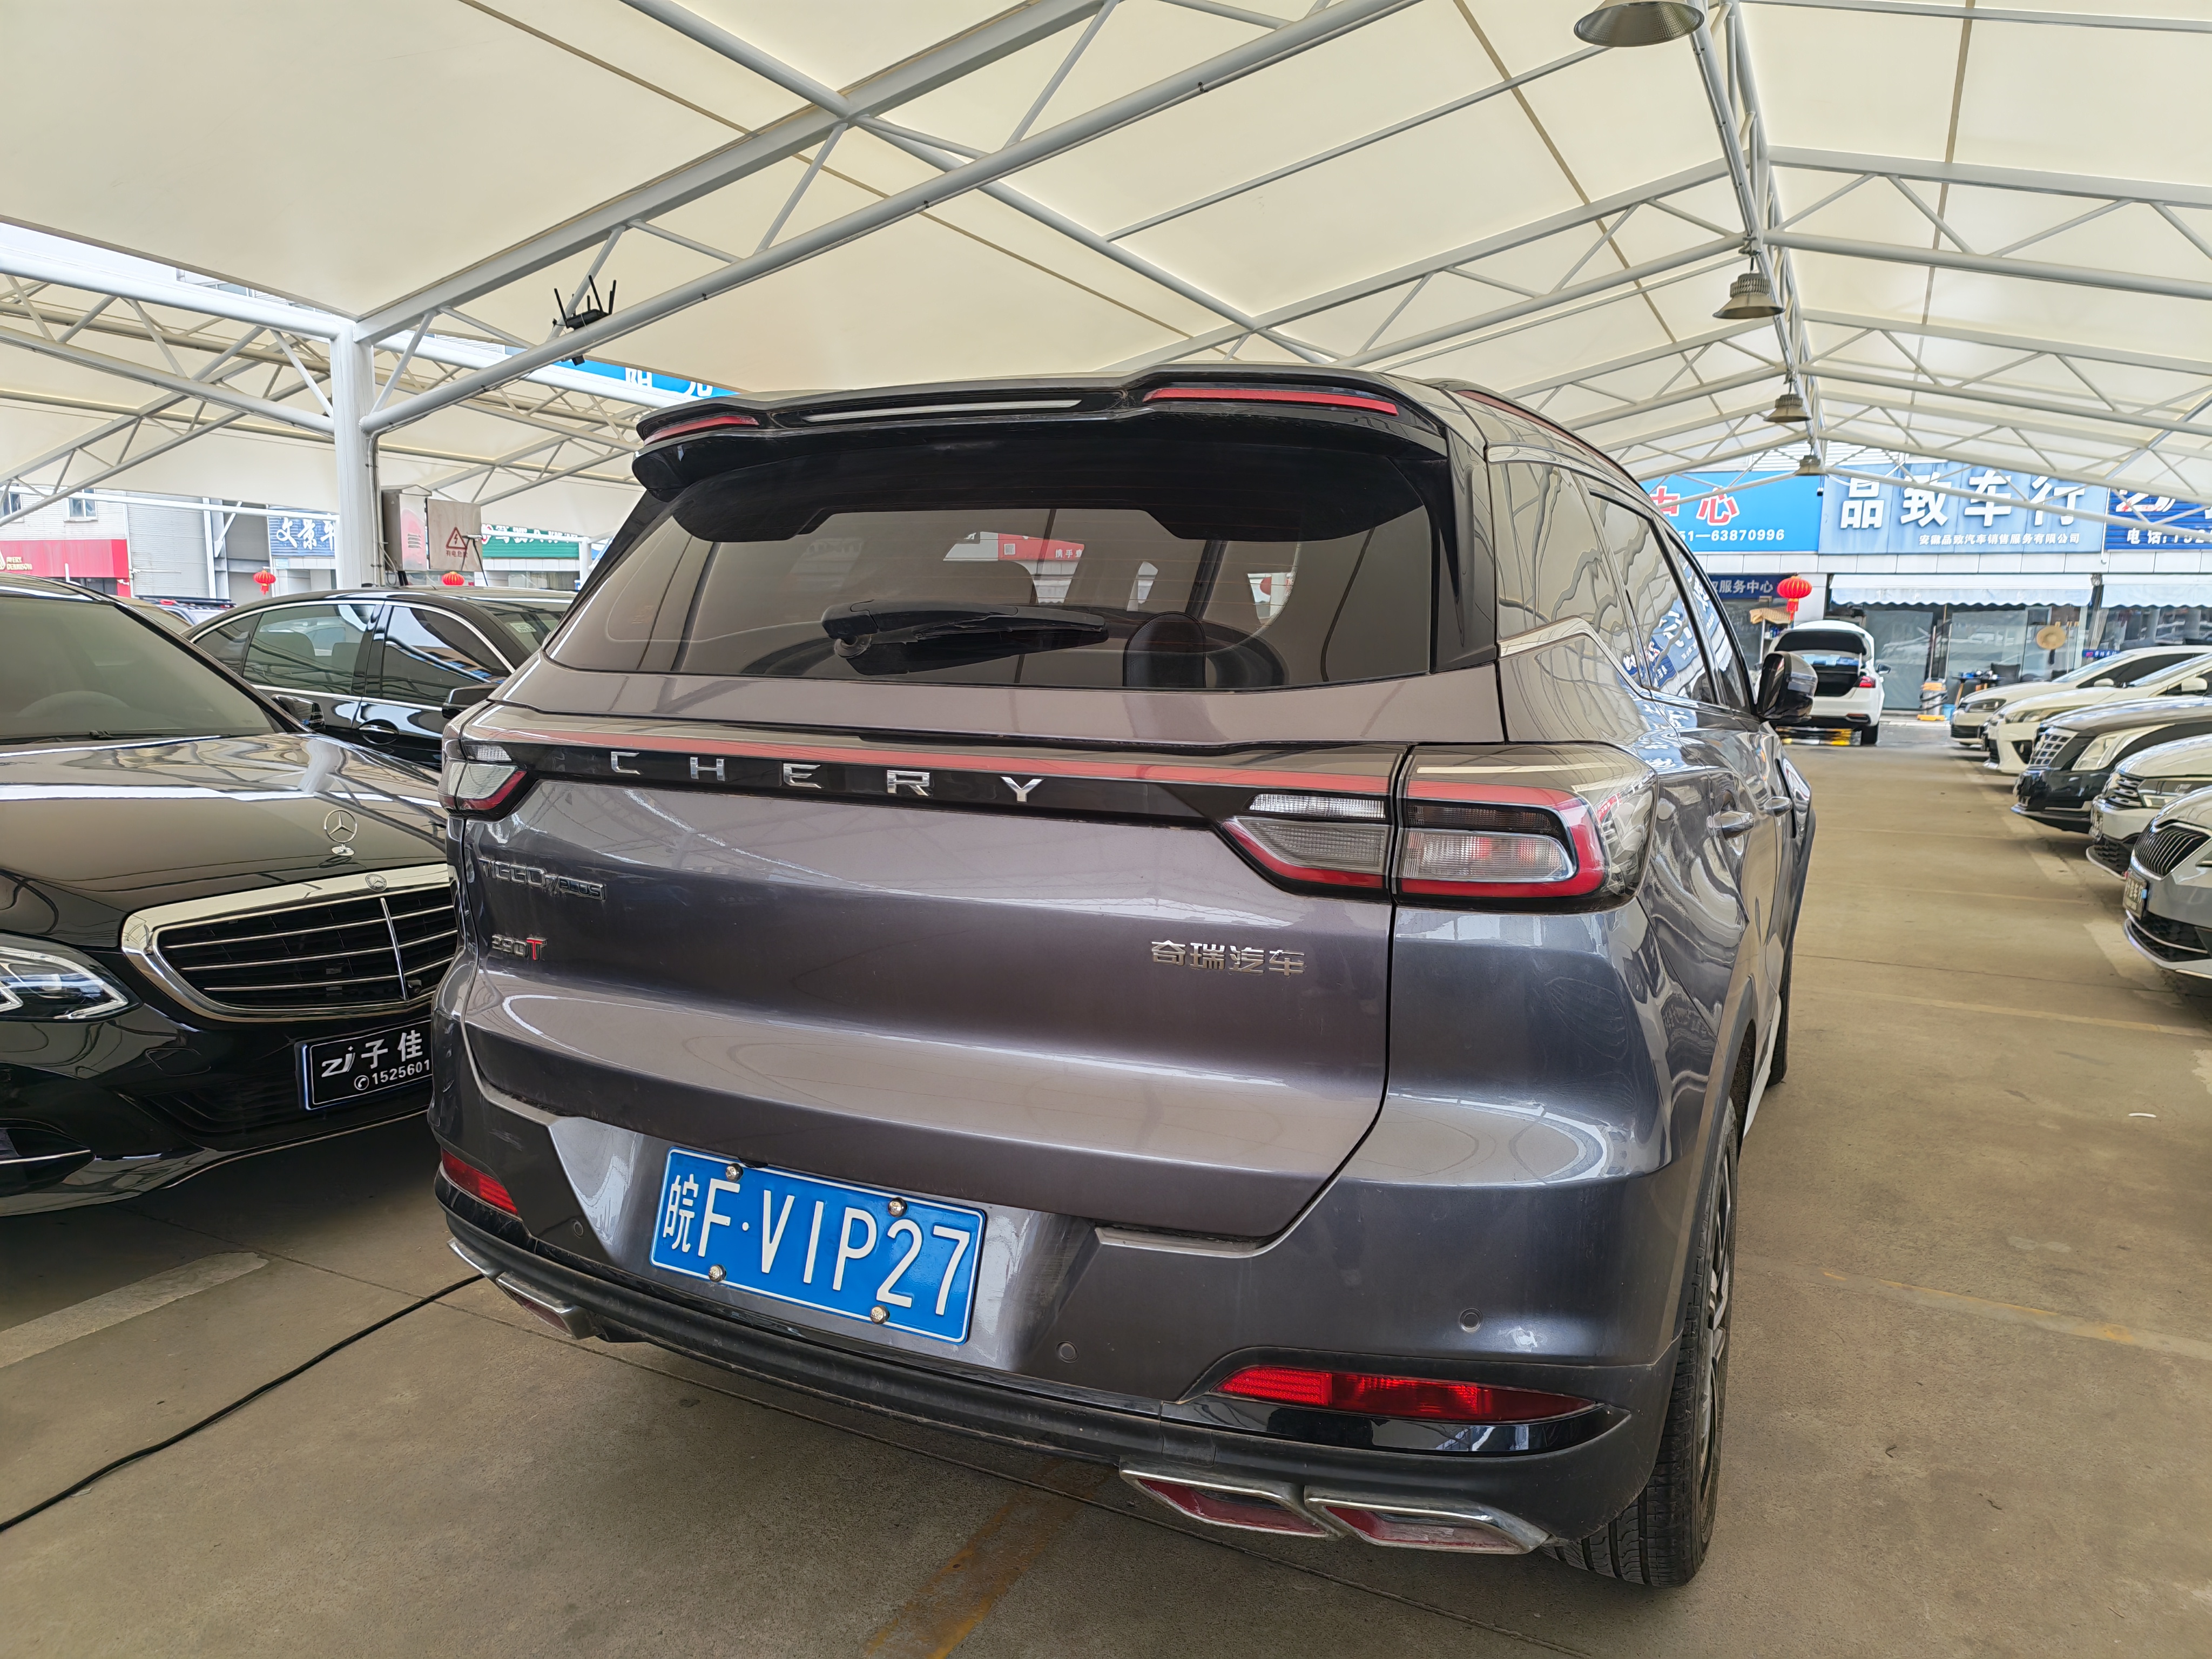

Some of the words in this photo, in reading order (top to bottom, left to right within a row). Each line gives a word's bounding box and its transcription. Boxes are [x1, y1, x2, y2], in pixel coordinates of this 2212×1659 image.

[1840, 469, 2085, 528] 品致车行
[1919, 532, 2080, 545] 安徽品致汽车销售服务有限公司
[610, 750, 1044, 803] CHERY
[1151, 940, 1305, 976] 奇瑞汽车
[361, 1029, 423, 1069] 子佳
[372, 1059, 430, 1085] 1525601
